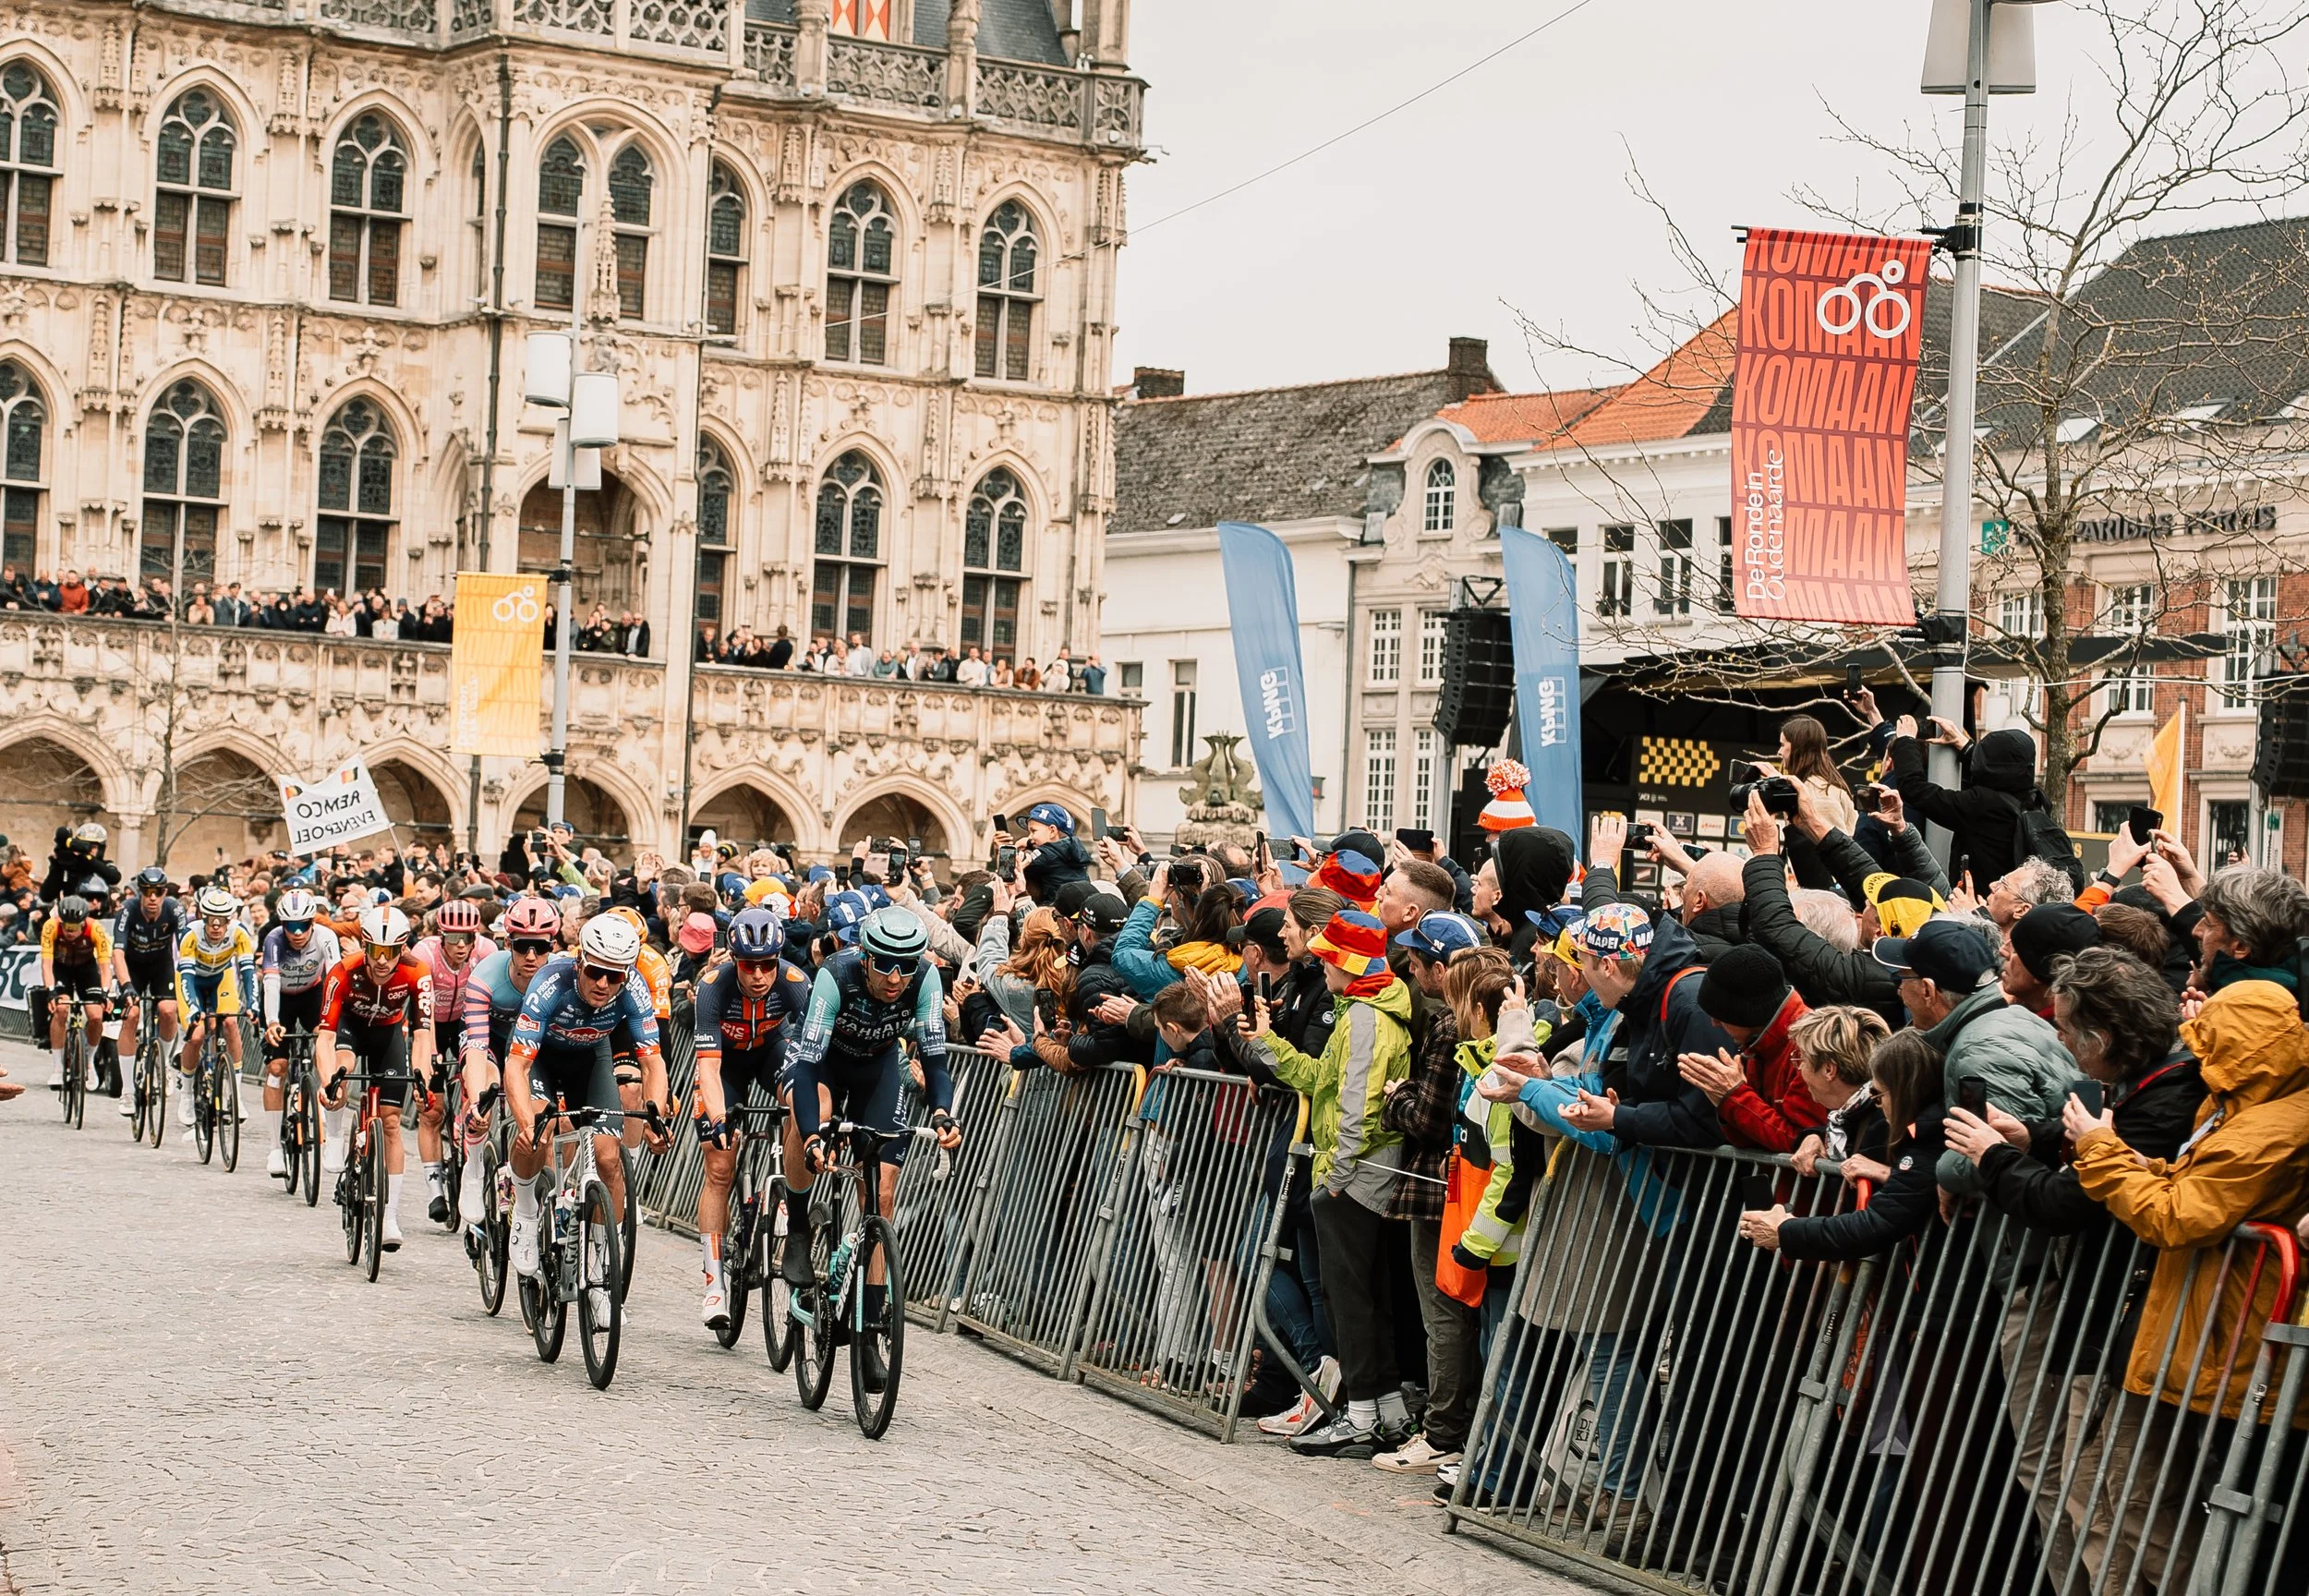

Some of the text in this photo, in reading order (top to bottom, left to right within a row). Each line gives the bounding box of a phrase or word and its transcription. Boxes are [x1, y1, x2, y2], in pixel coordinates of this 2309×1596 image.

[1744, 228, 1932, 284] KOMAAN
[1742, 276, 1928, 361] KOMAAN
[1733, 352, 1916, 435] KOMAAN
[1733, 427, 1904, 511] KOMAAN
[1744, 472, 1767, 599] De Ronde in
[1763, 449, 1786, 600] Oudenaarde
[1587, 931, 1618, 949] MAPEI
[536, 973, 561, 996] PREMIER
[541, 984, 557, 1001] TECH
[629, 970, 652, 1011] Alpecin
[650, 964, 670, 1006] INEOS
[555, 1029, 608, 1041] Alpecin
